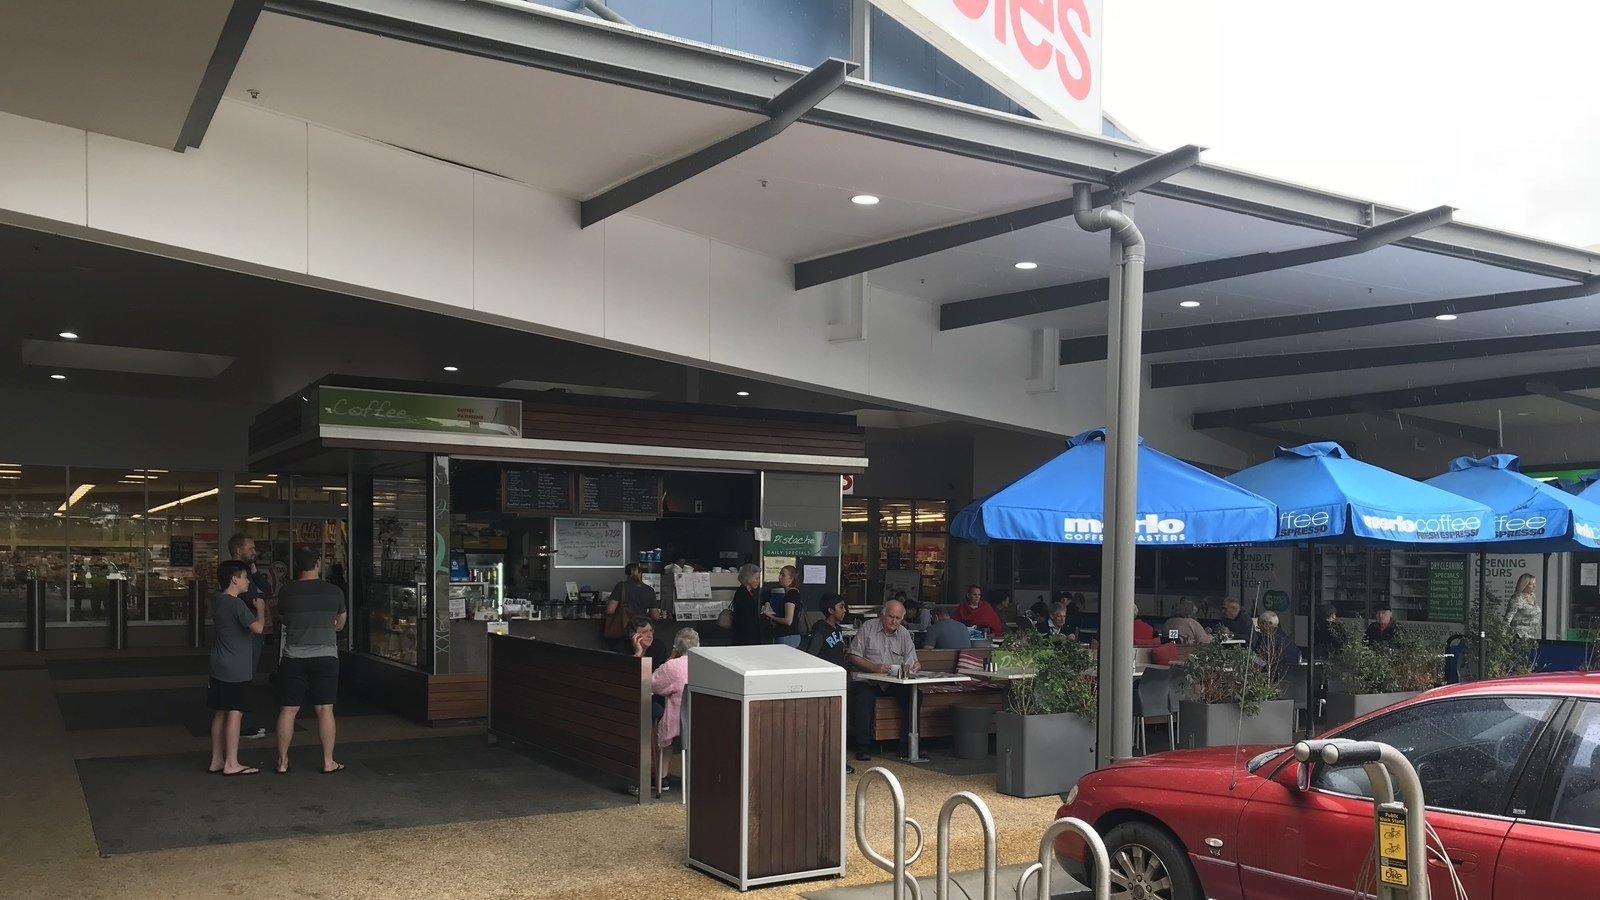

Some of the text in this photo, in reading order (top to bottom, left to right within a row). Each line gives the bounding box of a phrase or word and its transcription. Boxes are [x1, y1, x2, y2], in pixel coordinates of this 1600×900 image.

[334, 398, 409, 419] Coffee
[1064, 513, 1185, 534] mrlo
[1280, 511, 1330, 529] ffee
[1280, 524, 1328, 537] SPRESSO
[1417, 530, 1439, 540] FRESH
[772, 534, 816, 545] Pistache
[1064, 533, 1186, 542] COFFE ASTERS
[1264, 554, 1272, 562] IT
[1232, 562, 1274, 571] FOR LESS?
[1232, 571, 1256, 579] W'LL
